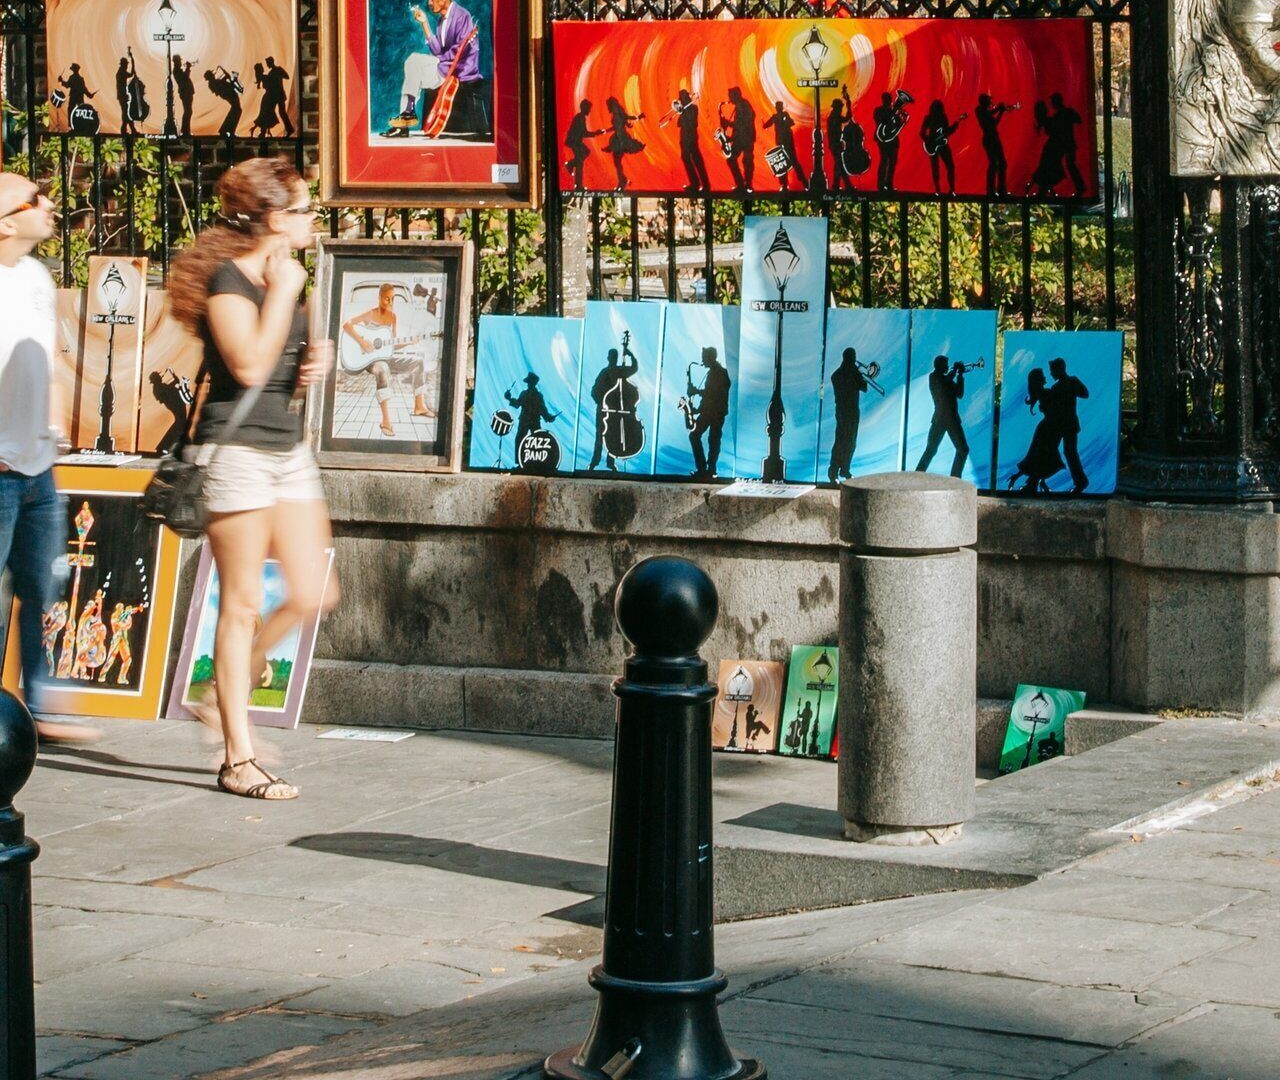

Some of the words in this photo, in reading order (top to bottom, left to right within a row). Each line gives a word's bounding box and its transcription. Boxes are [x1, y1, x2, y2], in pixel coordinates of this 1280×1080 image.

[75, 109, 94, 120] JAZZ
[751, 301, 766, 311] NEW
[769, 301, 806, 312] ORLEANS
[525, 436, 552, 450] JAZZ
[523, 449, 548, 463] BAND
